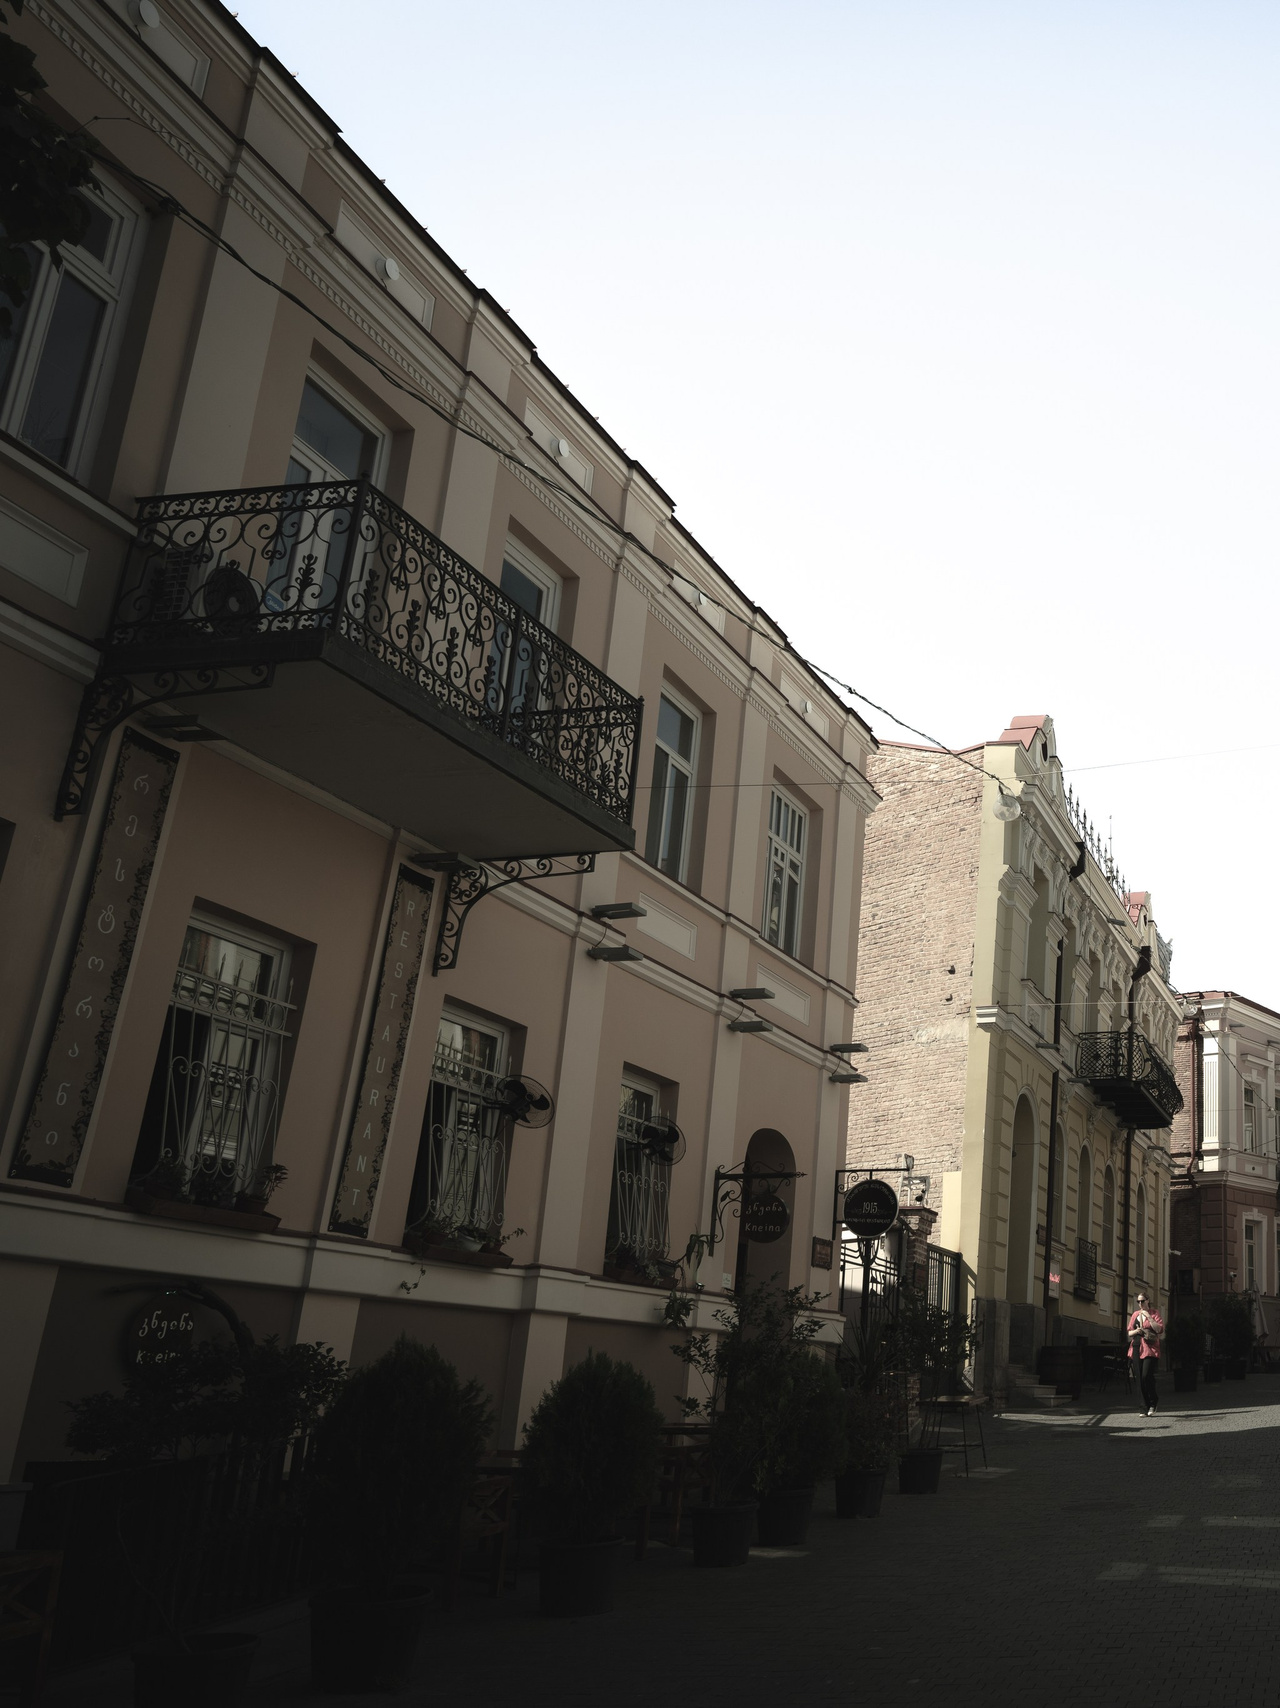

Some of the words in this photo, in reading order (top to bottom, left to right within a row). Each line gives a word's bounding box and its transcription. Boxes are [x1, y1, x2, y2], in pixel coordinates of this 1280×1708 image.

[45, 774, 150, 1146] რესტორანი
[352, 900, 416, 1206] RESTAURANT
[862, 1201, 878, 1214] 1915
[745, 1222, 781, 1232] Kneina
[136, 1349, 181, 1364] Kein
